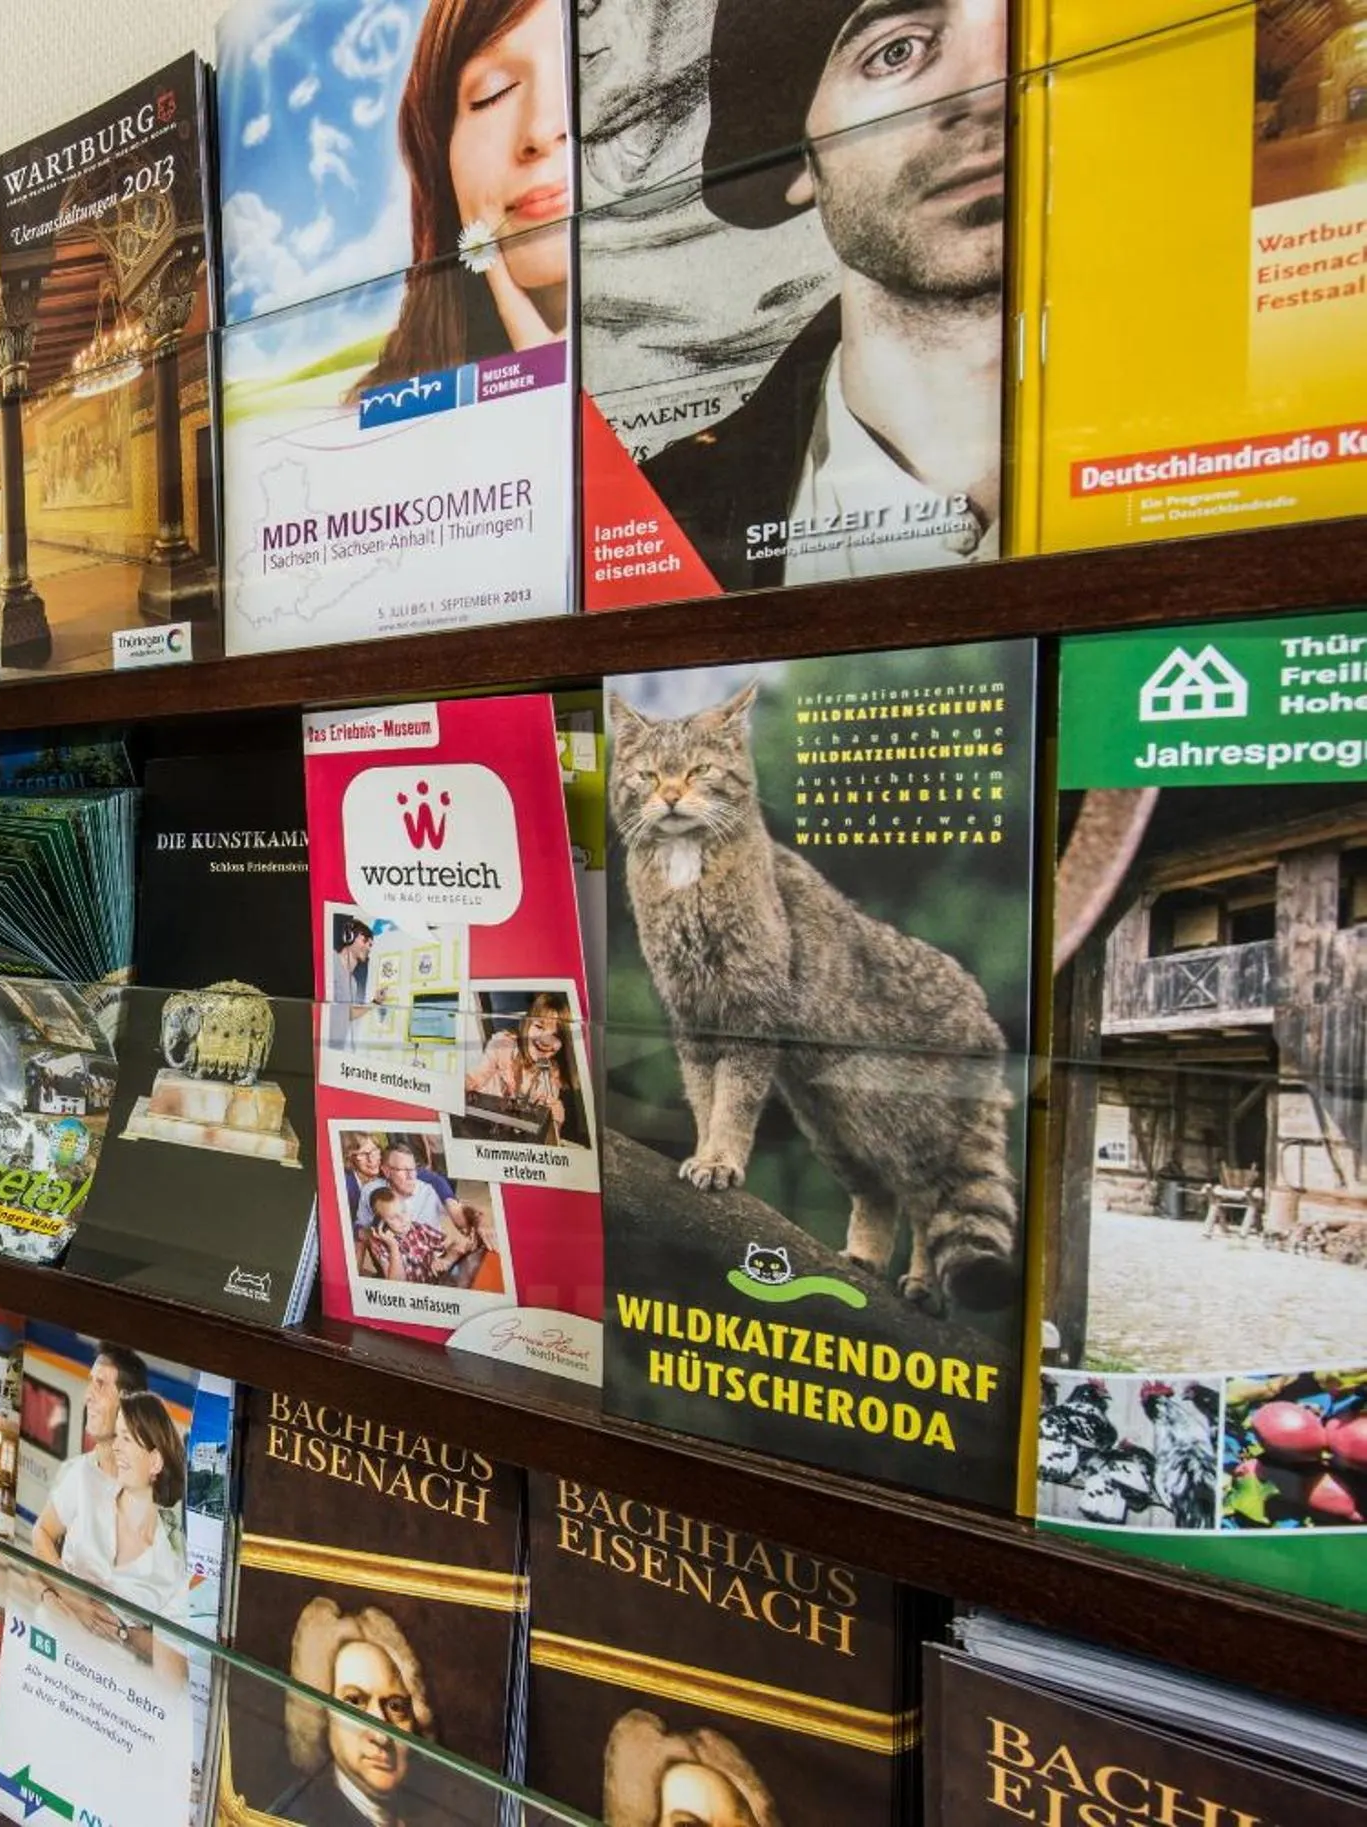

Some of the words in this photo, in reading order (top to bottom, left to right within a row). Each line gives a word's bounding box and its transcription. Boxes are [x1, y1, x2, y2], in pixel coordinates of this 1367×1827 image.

[3, 103, 155, 197] WARTBURG
[120, 154, 176, 202] 2013
[1257, 275, 1366, 313] Festsaal
[482, 363, 521, 382] MUSIK
[482, 374, 535, 397] SOMMER
[362, 377, 441, 415] mdr
[1081, 435, 1329, 490] Deutschlandradio
[262, 518, 318, 551] MDR
[326, 479, 532, 541] MUSIKSOMMER
[746, 506, 893, 545] SPIELZEIT
[903, 493, 970, 524] 12/13
[269, 547, 320, 572] Sachsen
[331, 528, 436, 561] Sachsen-Anhalt
[447, 514, 524, 542] Thüringen
[594, 519, 660, 542] landes
[594, 538, 665, 562] theater
[594, 555, 681, 582] eisenach
[440, 595, 500, 612] SEPTEMBER
[503, 588, 532, 604] 2013
[1280, 634, 1365, 659] Thür
[796, 698, 1005, 724] WILDKATZENSCHEUNE
[330, 720, 432, 742] Erlebnis-Museum
[796, 743, 1004, 764] WILDKATZENLICHTUNG
[1135, 739, 1367, 770] Jahresprog
[796, 787, 1004, 805] HAINICHBLICK
[157, 832, 187, 850] DIE
[796, 831, 1003, 845] WILDKATZENPFAD
[209, 861, 245, 873] Schloss
[361, 860, 502, 889] wortreich
[339, 1062, 378, 1084] Sprache
[380, 1067, 431, 1094] entdecken
[475, 1145, 570, 1167] Kommunikation
[503, 1165, 546, 1182] erleben
[30, 1216, 62, 1233] Wald
[365, 1289, 408, 1310] Wissen
[409, 1294, 461, 1316] anfassen
[617, 1294, 999, 1403] WILDKATZENDORF
[649, 1349, 956, 1453] HÜTSCHERODA
[269, 1392, 494, 1482] BACHHAUS
[266, 1423, 491, 1525] EISENACH
[557, 1478, 859, 1608] BACHHAUS
[556, 1513, 857, 1657] EISENACH
